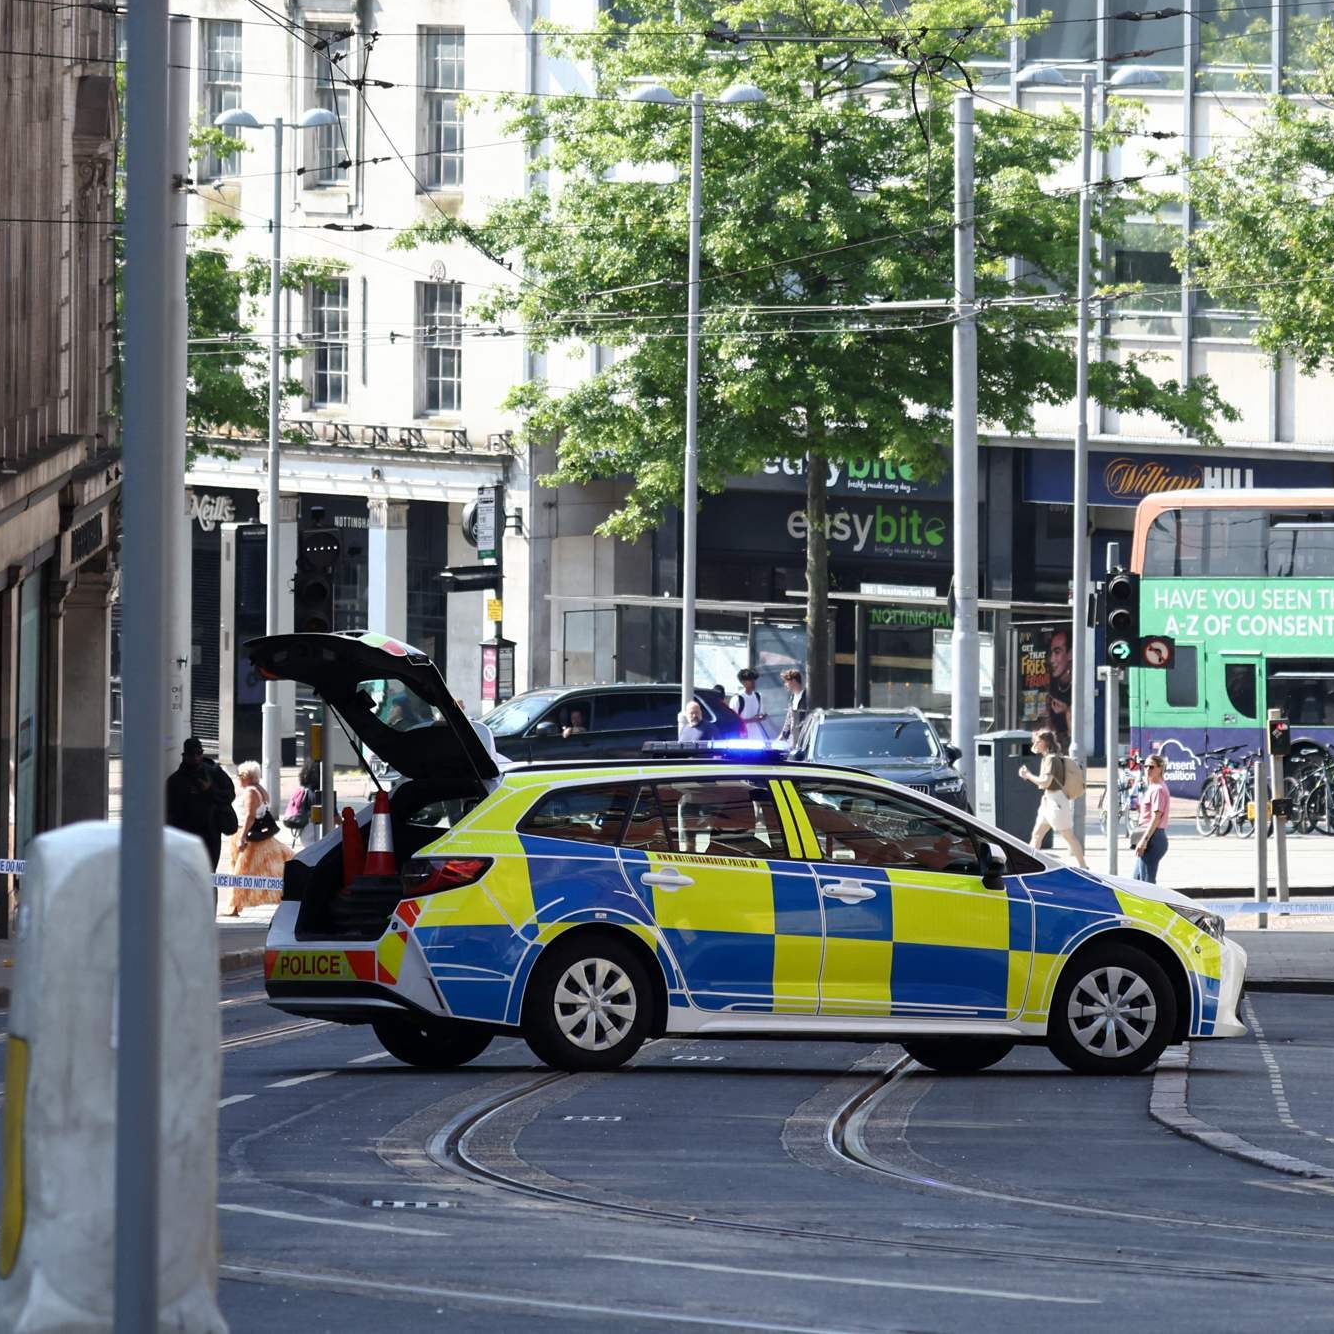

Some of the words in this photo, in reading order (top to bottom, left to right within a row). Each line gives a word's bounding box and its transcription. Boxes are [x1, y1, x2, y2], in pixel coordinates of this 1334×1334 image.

[787, 505, 946, 552] esybite
[1154, 589, 1207, 610] HAVE
[1212, 589, 1256, 610] YOU
[1262, 589, 1312, 610] SEEN
[1165, 615, 1199, 636] A-Z
[1203, 615, 1231, 636] OF
[1163, 769, 1196, 781] oalition
[5, 860, 15, 872] DO
[16, 861, 26, 873] NO
[229, 874, 243, 887] LINE
[243, 876, 253, 888] DO
[254, 877, 267, 889] NOT
[267, 878, 283, 890] CROS
[280, 955, 341, 975] POLICE
